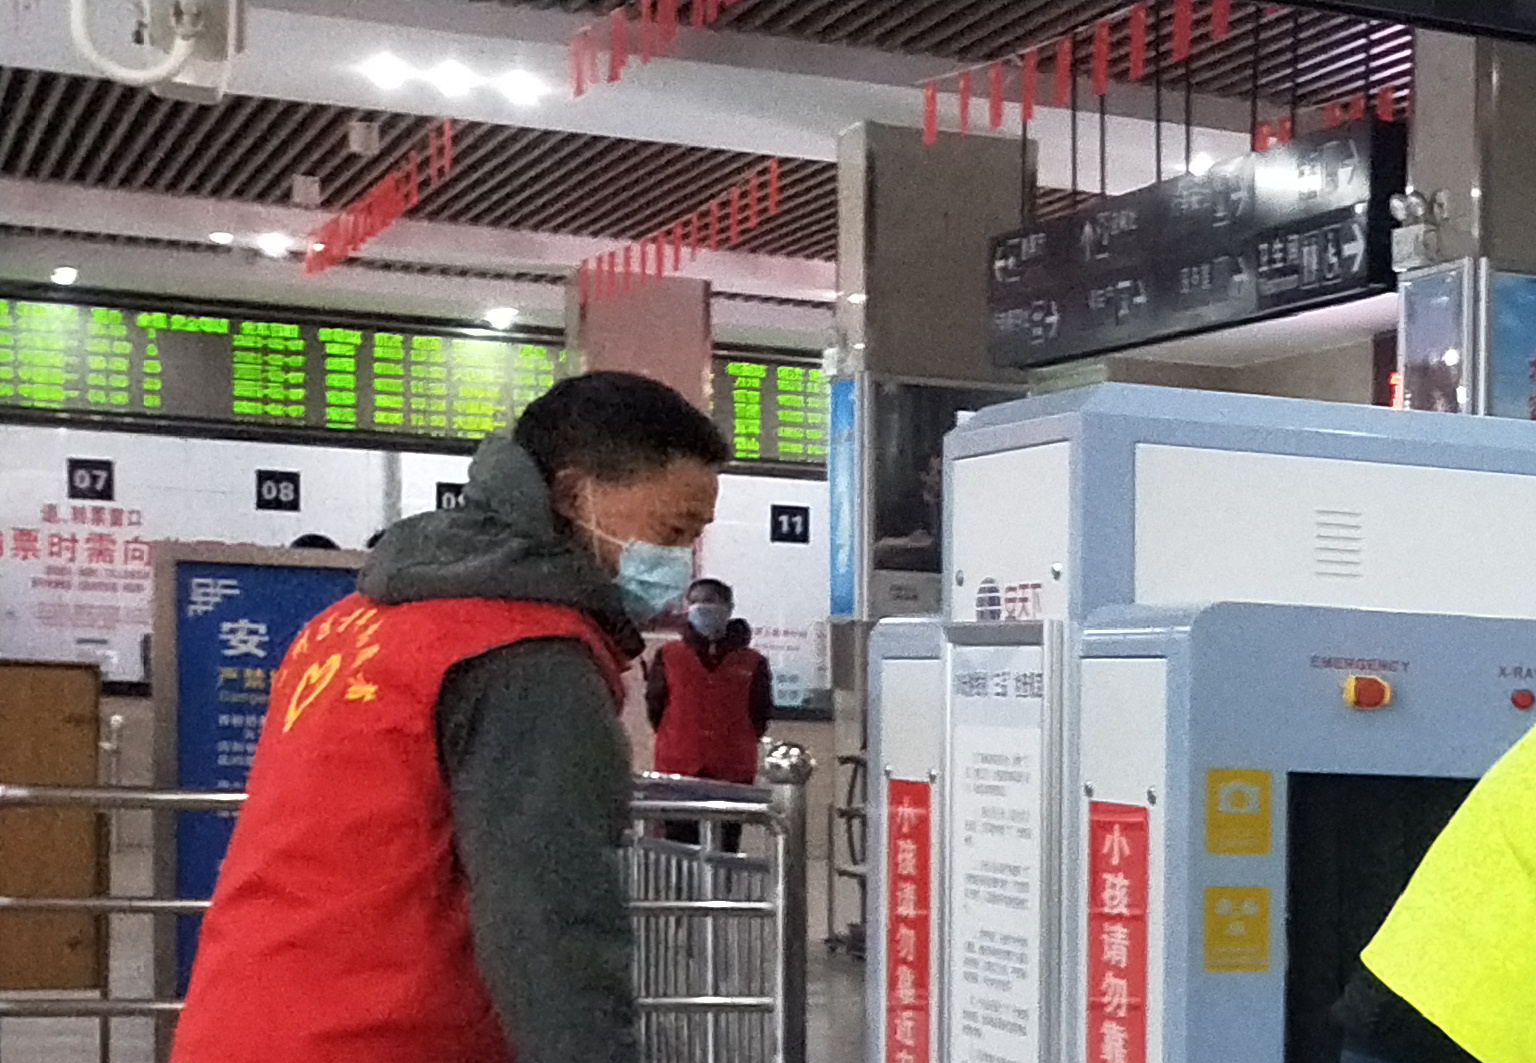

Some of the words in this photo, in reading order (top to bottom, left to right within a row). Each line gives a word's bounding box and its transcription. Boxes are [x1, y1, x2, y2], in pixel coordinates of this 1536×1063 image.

[73, 469, 108, 491] 07
[261, 480, 294, 501] 08
[442, 492, 465, 509] 0
[777, 514, 804, 534] 11
[0, 527, 150, 564] 票时需向
[219, 618, 269, 658] 安
[1310, 654, 1410, 673] EMERGENCY
